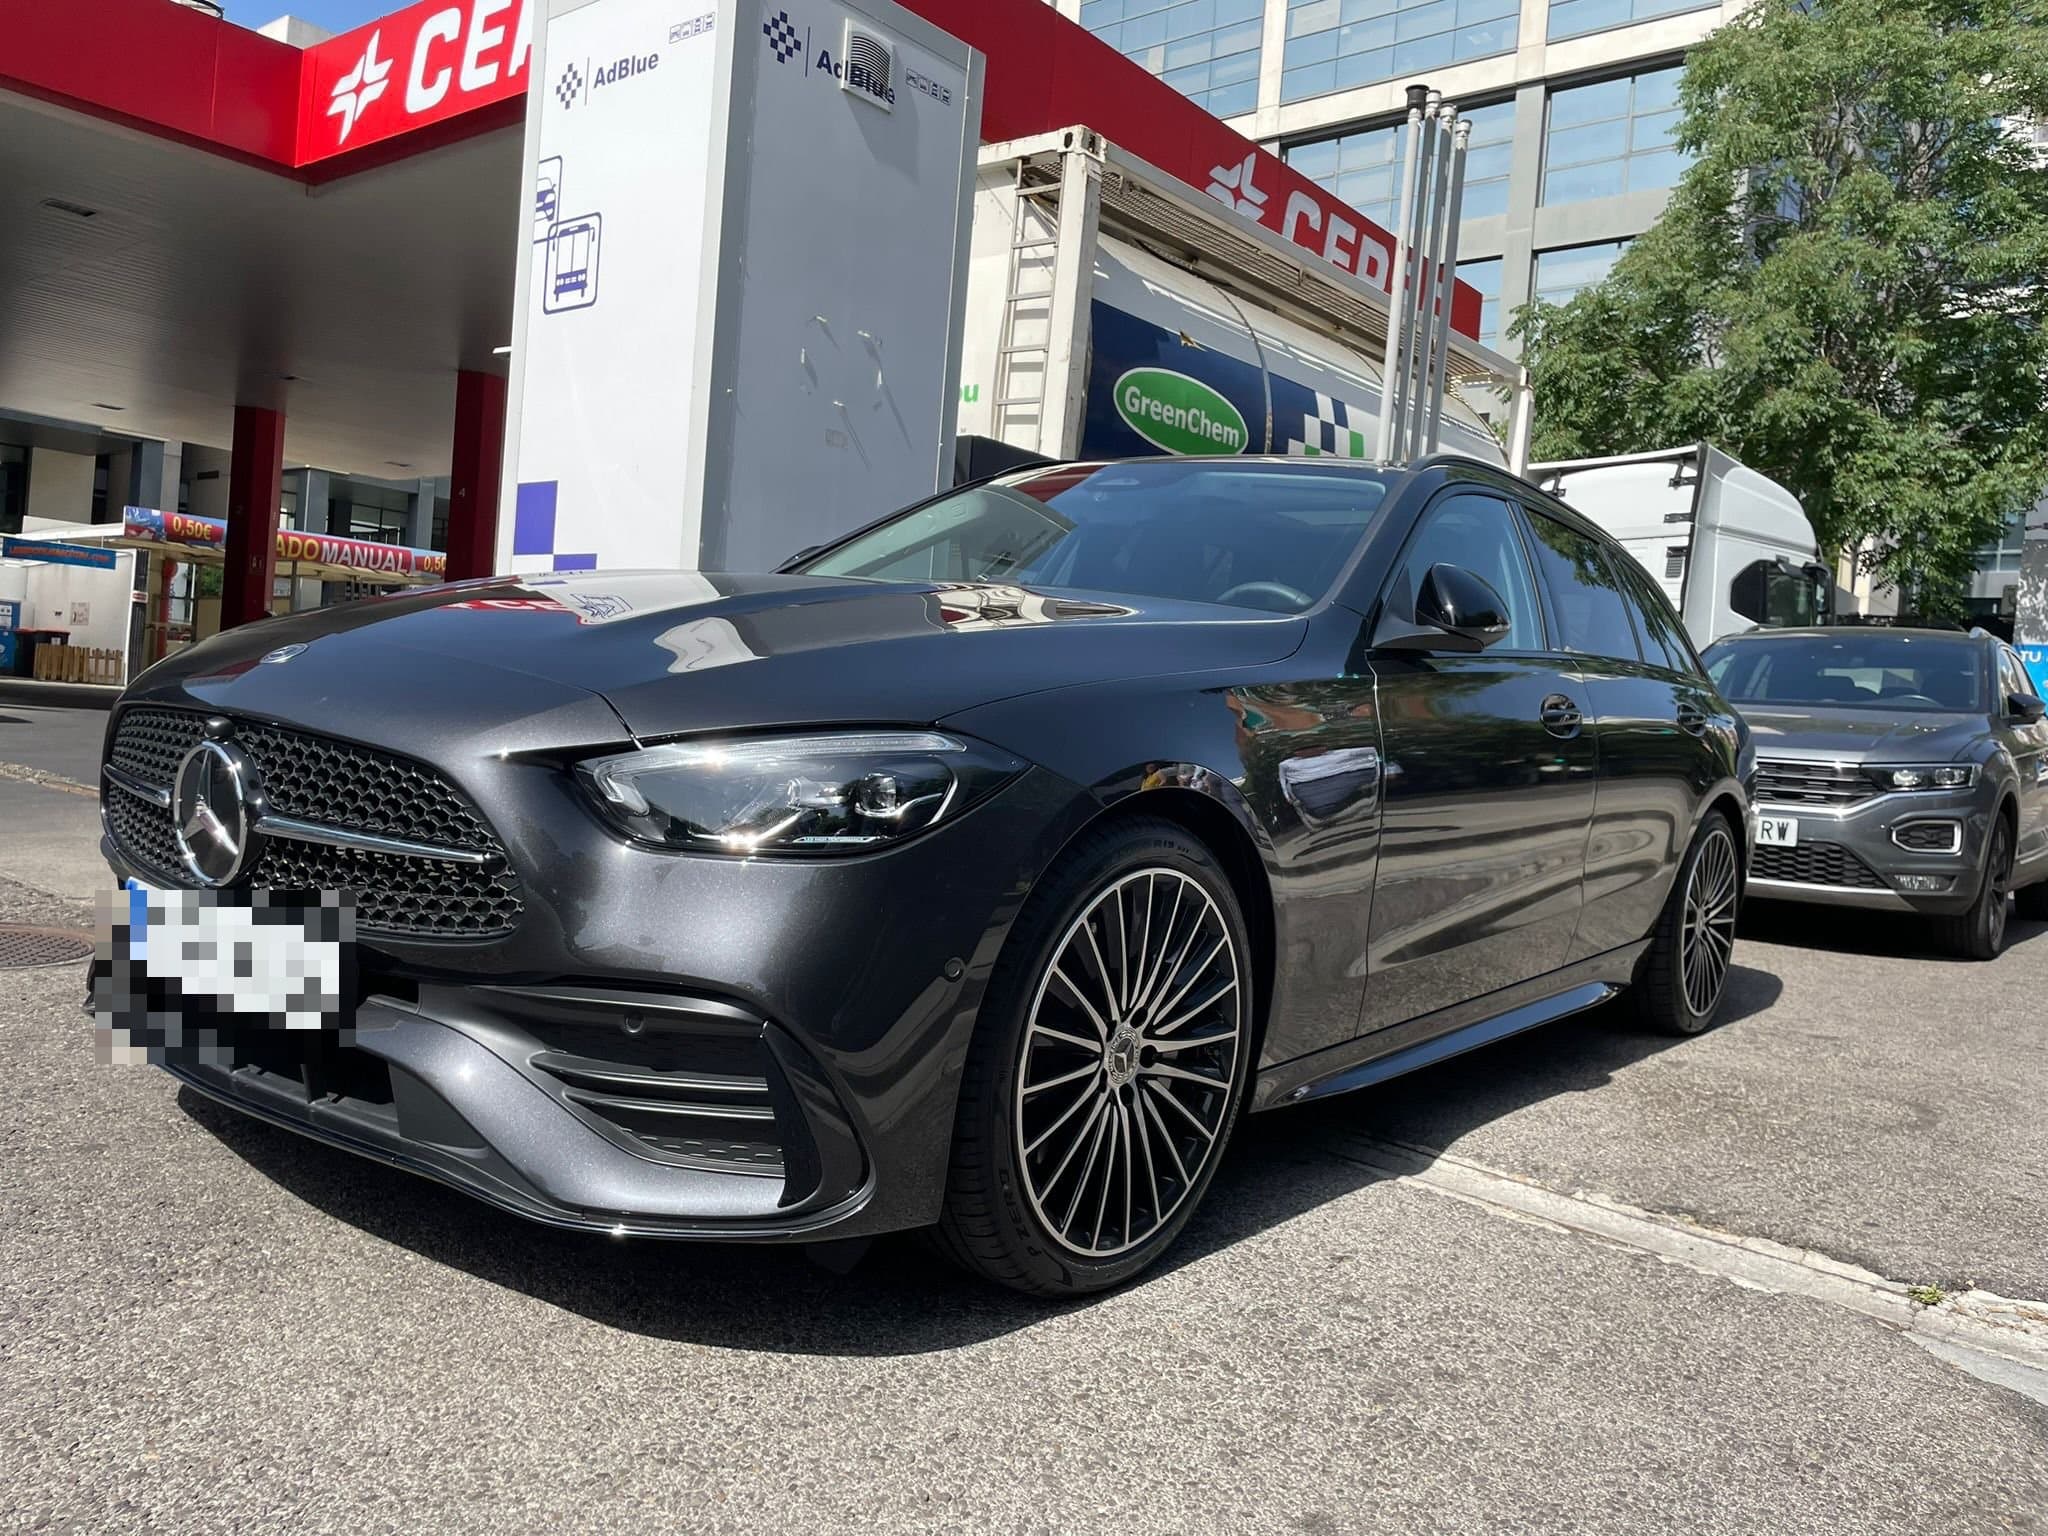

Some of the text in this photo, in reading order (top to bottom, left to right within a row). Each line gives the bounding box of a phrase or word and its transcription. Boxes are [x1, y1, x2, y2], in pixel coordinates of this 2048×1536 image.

[593, 52, 660, 89] AdBlue
[1124, 385, 1240, 448] GreenChem
[172, 515, 213, 541] 0,50€
[321, 540, 411, 576] MANUAL
